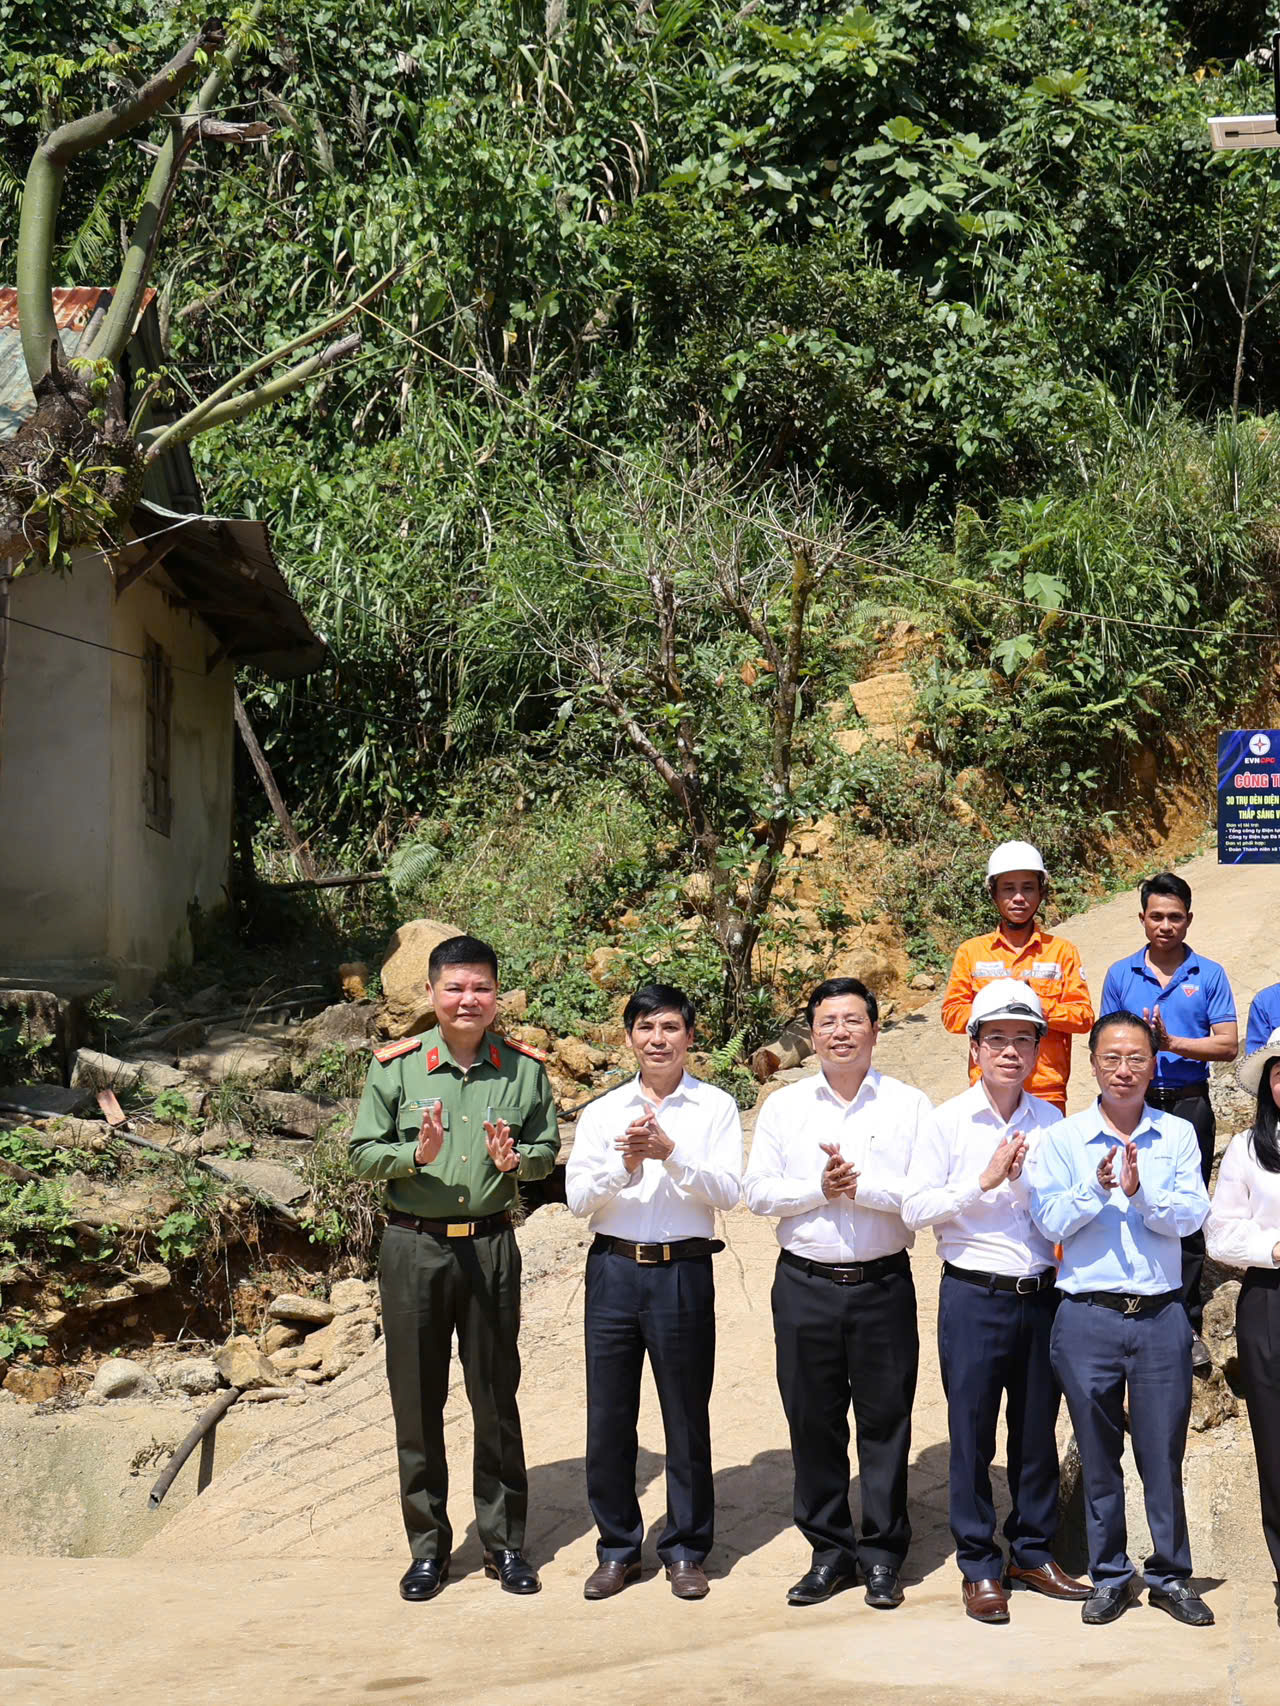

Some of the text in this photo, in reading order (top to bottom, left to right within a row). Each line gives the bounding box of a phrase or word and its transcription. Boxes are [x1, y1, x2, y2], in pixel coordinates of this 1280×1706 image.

[1234, 771, 1269, 788] CÔNG
[1226, 796, 1235, 805] 30
[1236, 796, 1248, 806] TRỤ
[1239, 807, 1255, 819] THẮP
[1257, 808, 1274, 819] SÁNG
